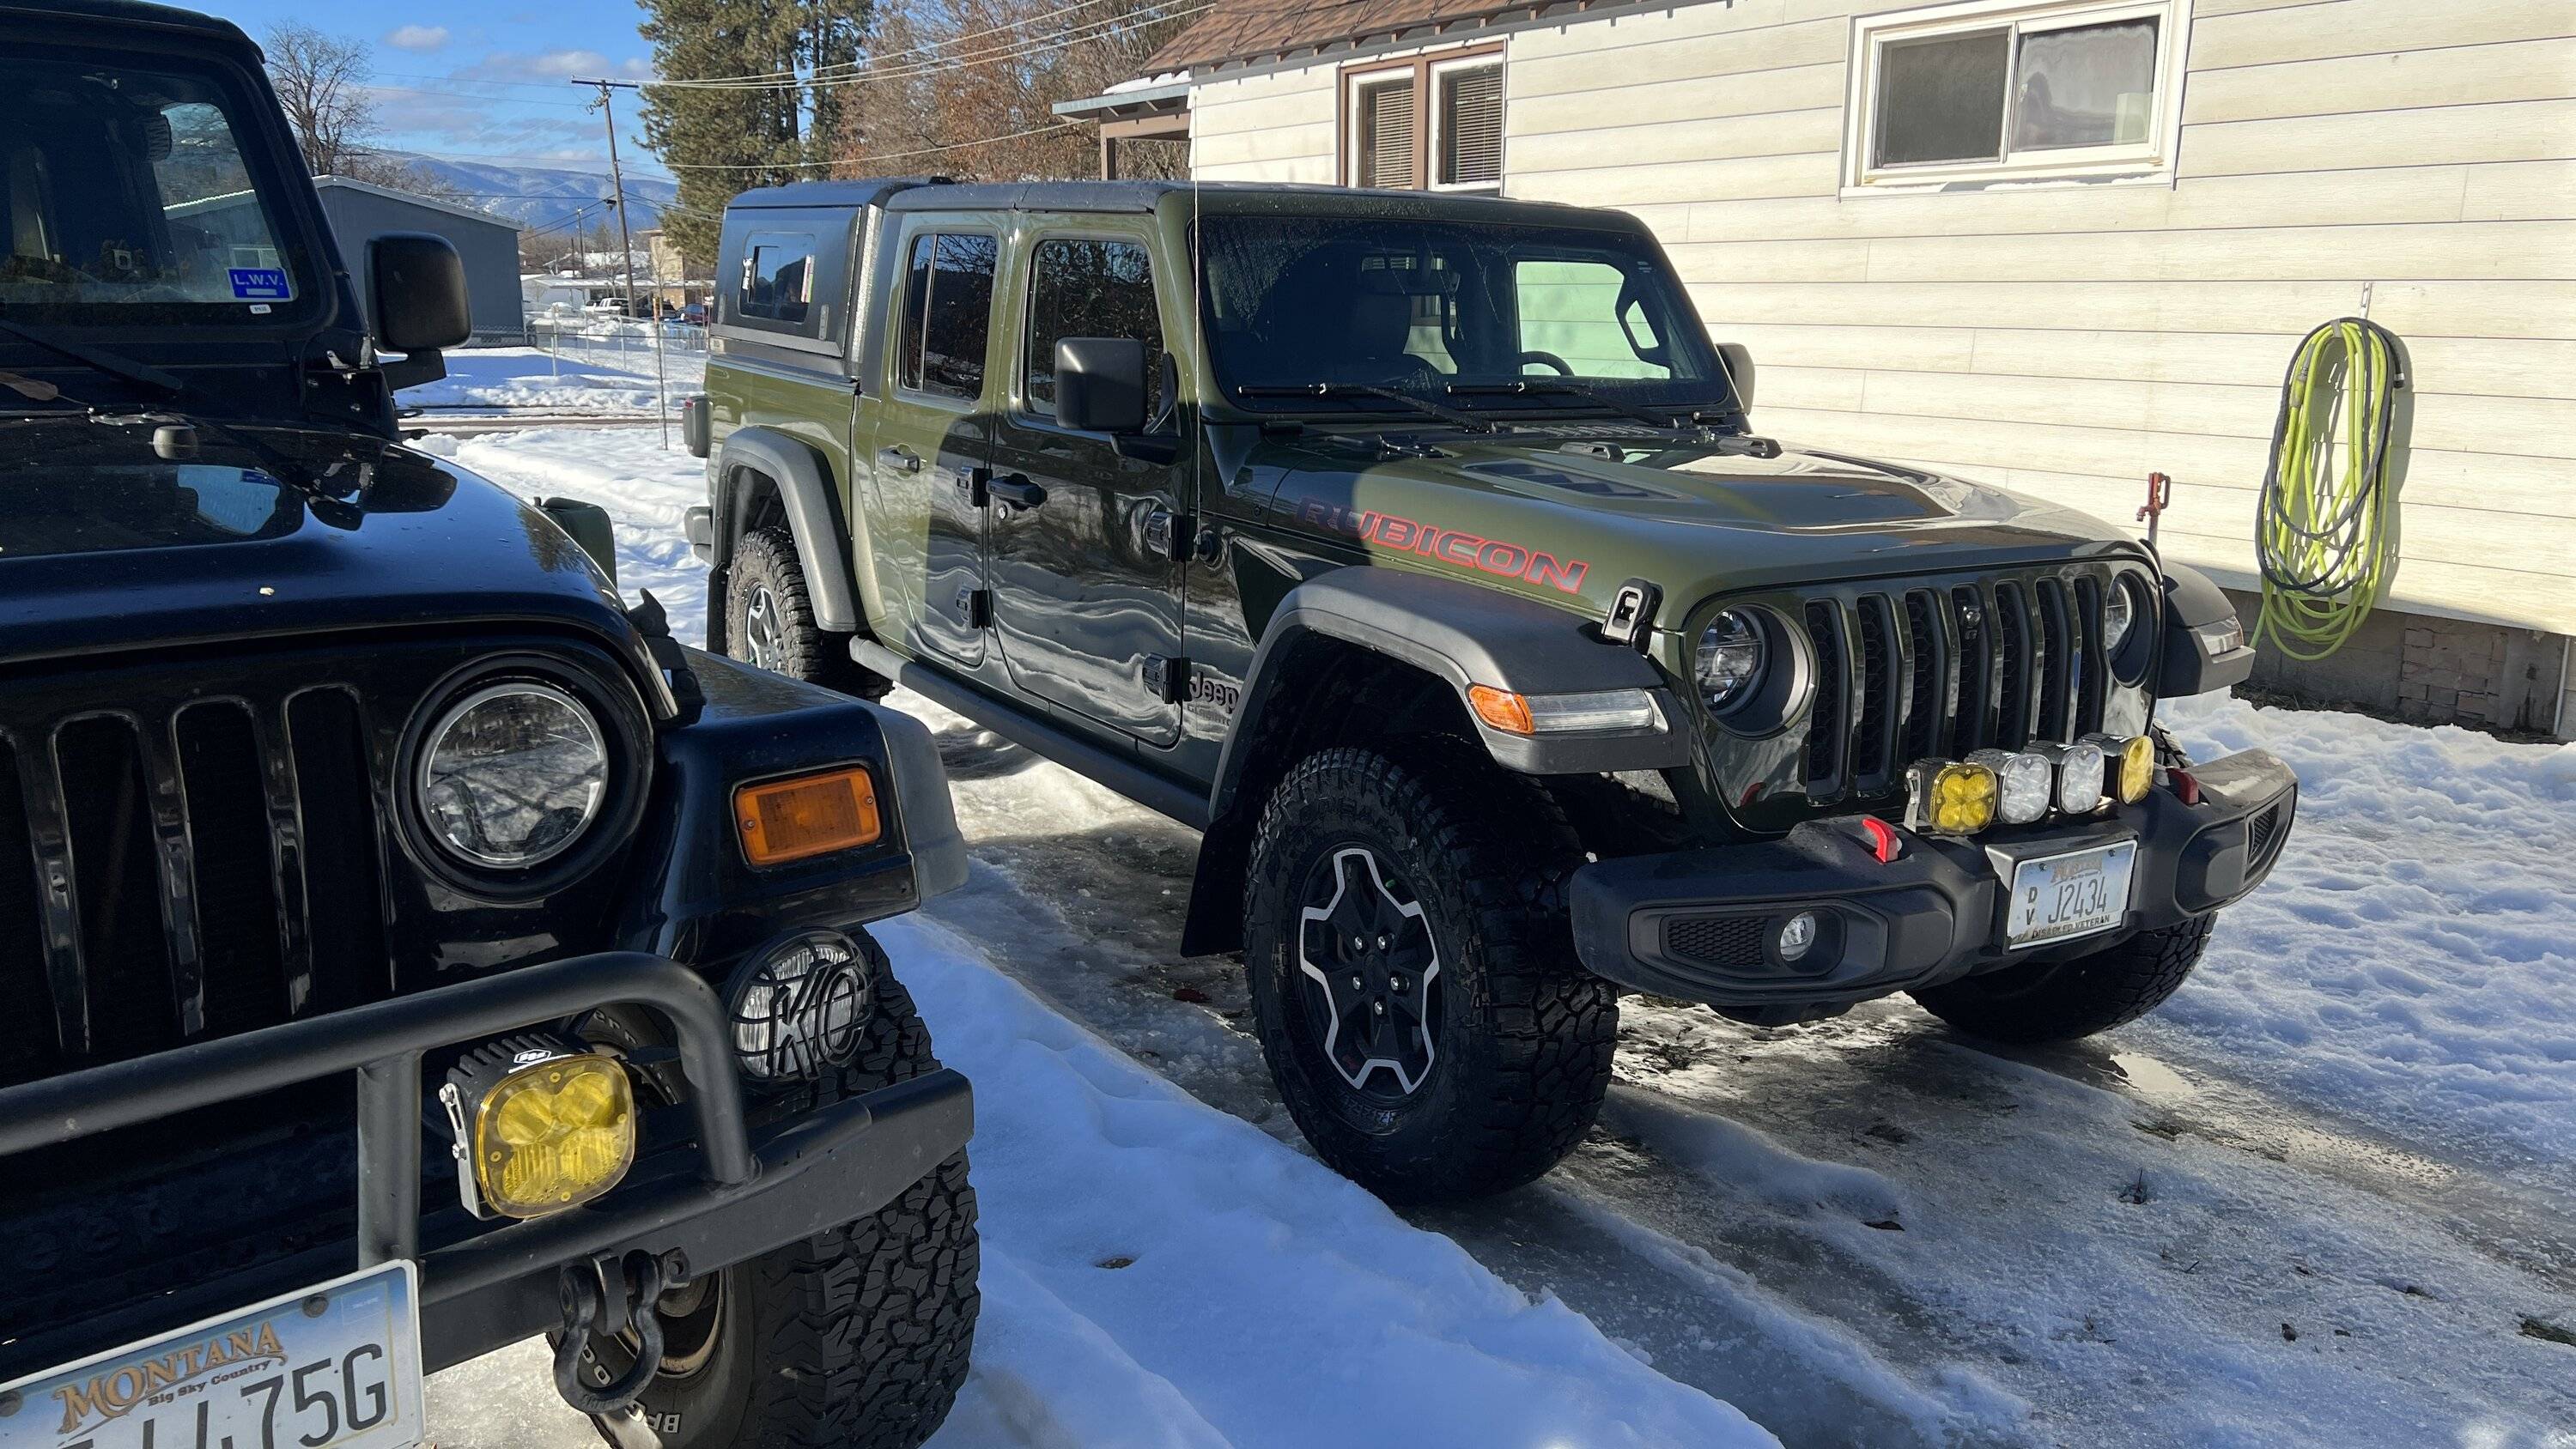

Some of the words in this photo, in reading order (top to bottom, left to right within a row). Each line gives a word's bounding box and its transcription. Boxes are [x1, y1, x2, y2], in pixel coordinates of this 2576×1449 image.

[234, 274, 283, 286] L.W.V.
[1297, 495, 1589, 594] RUBICON
[1189, 671, 1239, 714] Jeep
[2048, 876, 2107, 924] J2434
[2075, 914, 2111, 928] VETERAN
[52, 1320, 286, 1434] MONTANA
[148, 1391, 174, 1407] Big
[177, 1381, 208, 1397] Sky
[210, 1360, 272, 1385] Country
